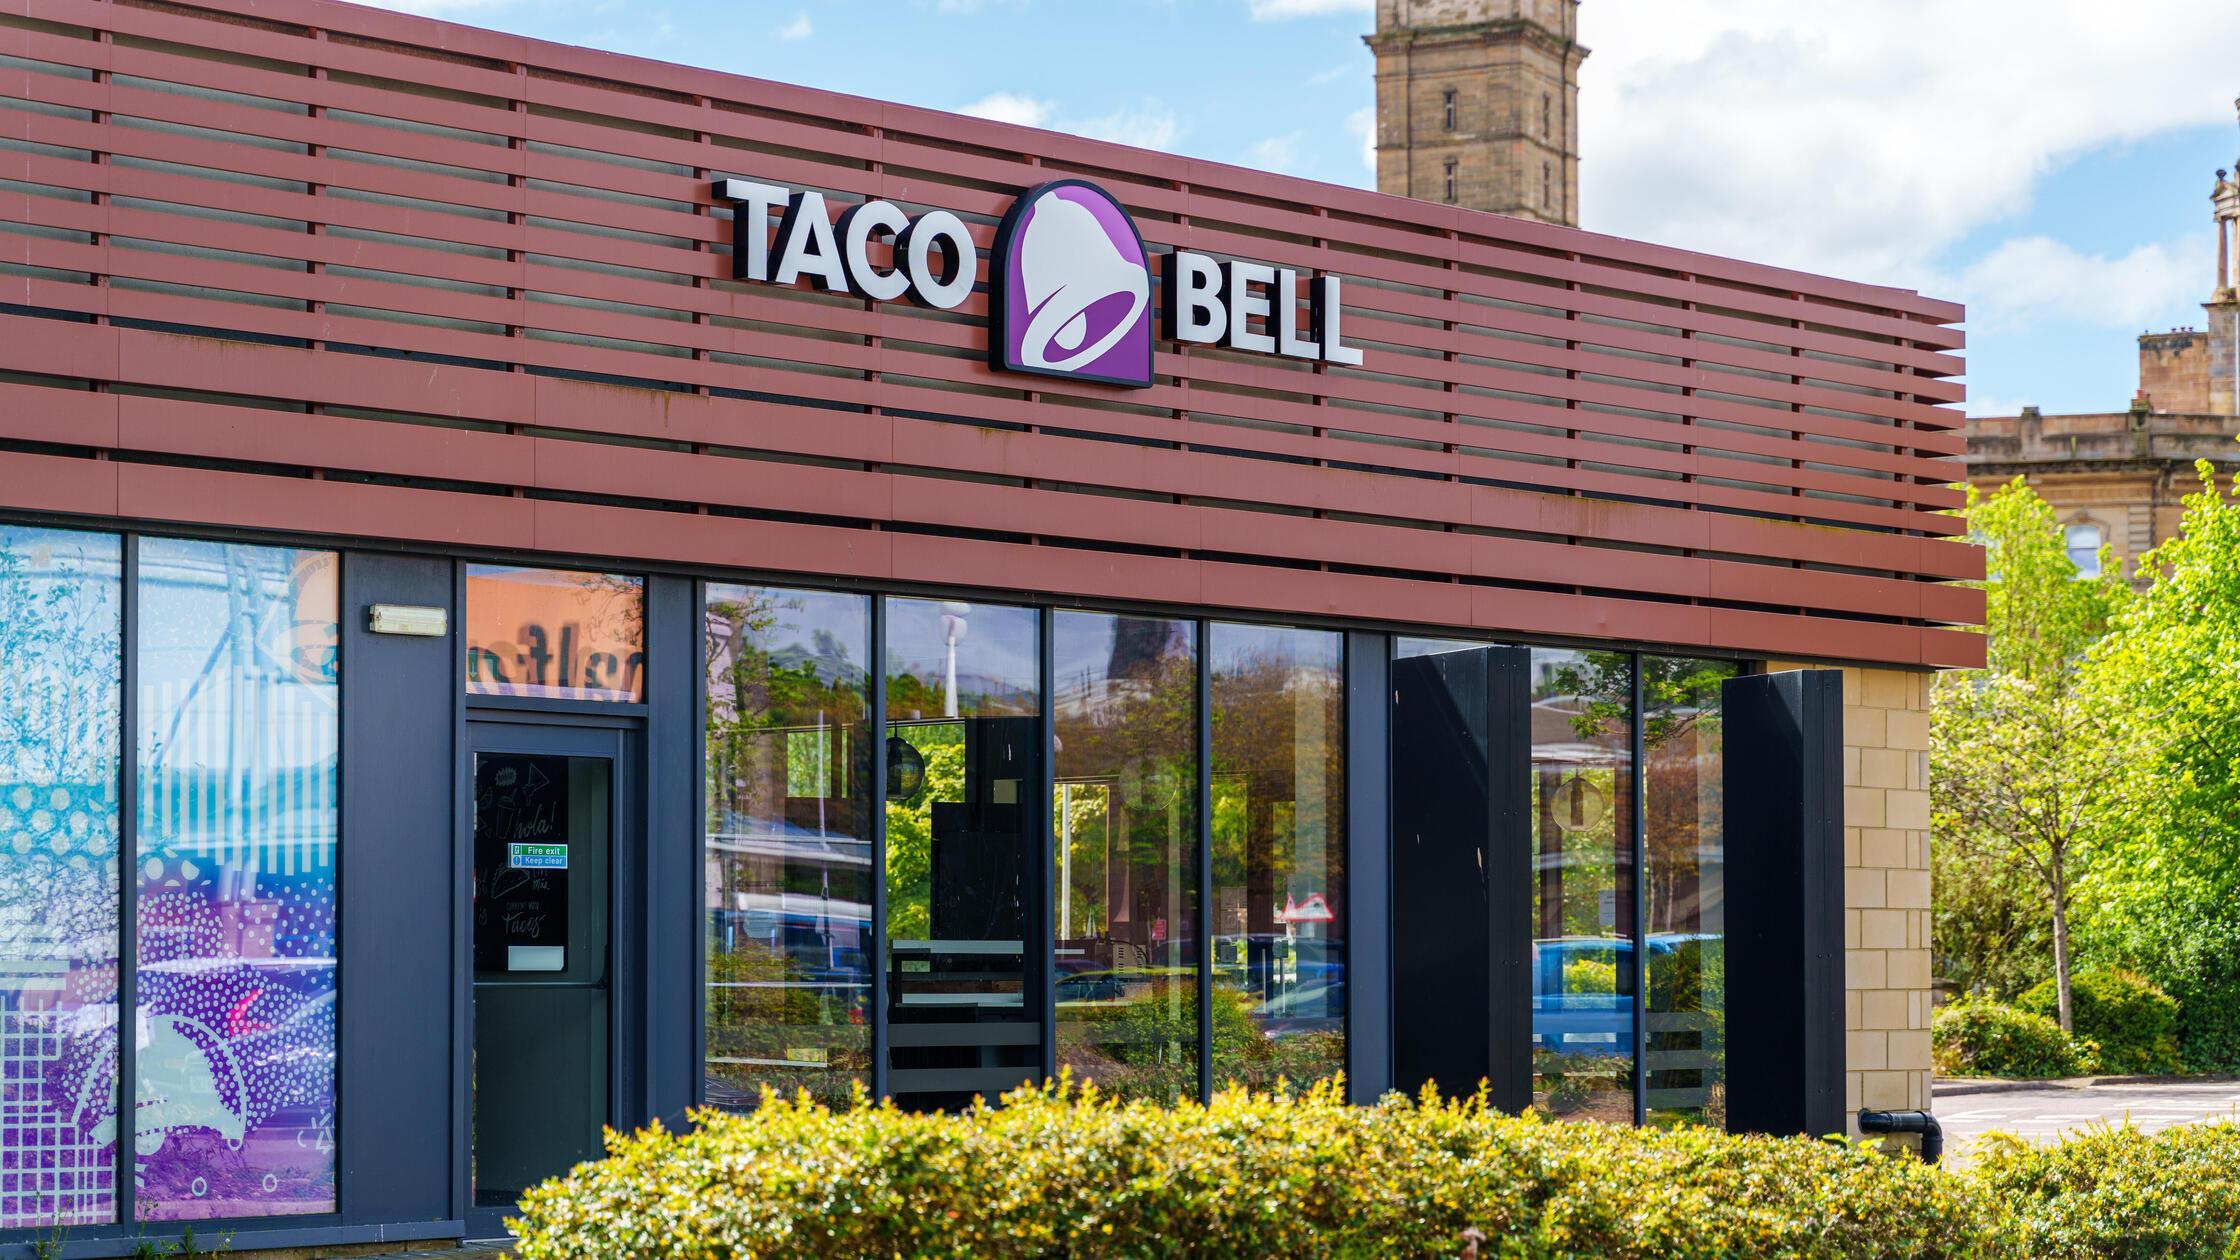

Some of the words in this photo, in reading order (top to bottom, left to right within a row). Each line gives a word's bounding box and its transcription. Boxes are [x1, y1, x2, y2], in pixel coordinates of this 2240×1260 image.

[726, 178, 977, 310] TACO
[1175, 251, 1364, 366] BELL
[527, 846, 544, 855] Fire
[545, 847, 561, 855] exit
[525, 856, 543, 866] Keep
[544, 857, 563, 865] clear
